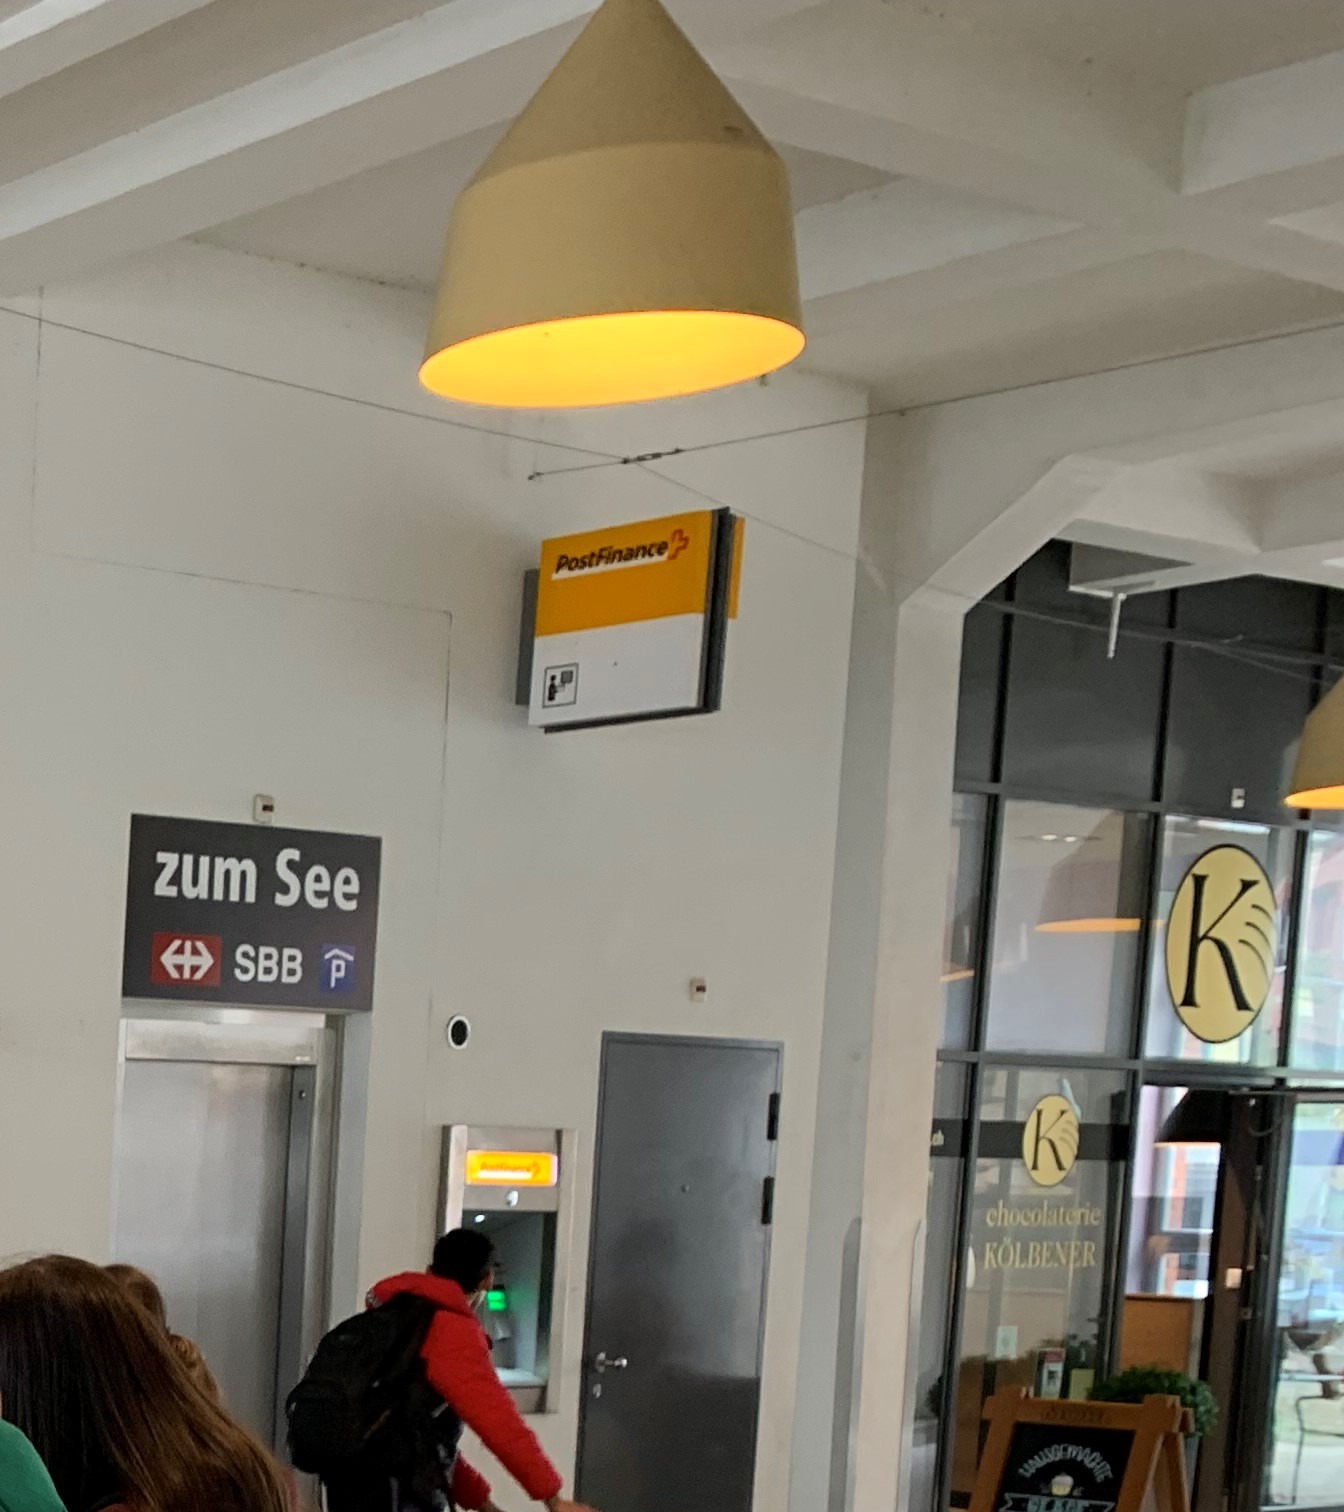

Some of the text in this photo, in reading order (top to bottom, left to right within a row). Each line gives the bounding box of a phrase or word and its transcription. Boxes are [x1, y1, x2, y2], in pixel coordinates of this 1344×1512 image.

[555, 539, 669, 574] PostFinance
[153, 847, 360, 911] zum See
[1179, 872, 1260, 1013] K
[233, 943, 346, 989] SBB P
[1030, 1107, 1068, 1172] K
[985, 1199, 1102, 1228] chocolaterie
[982, 1238, 1097, 1270] KÖLBENER
